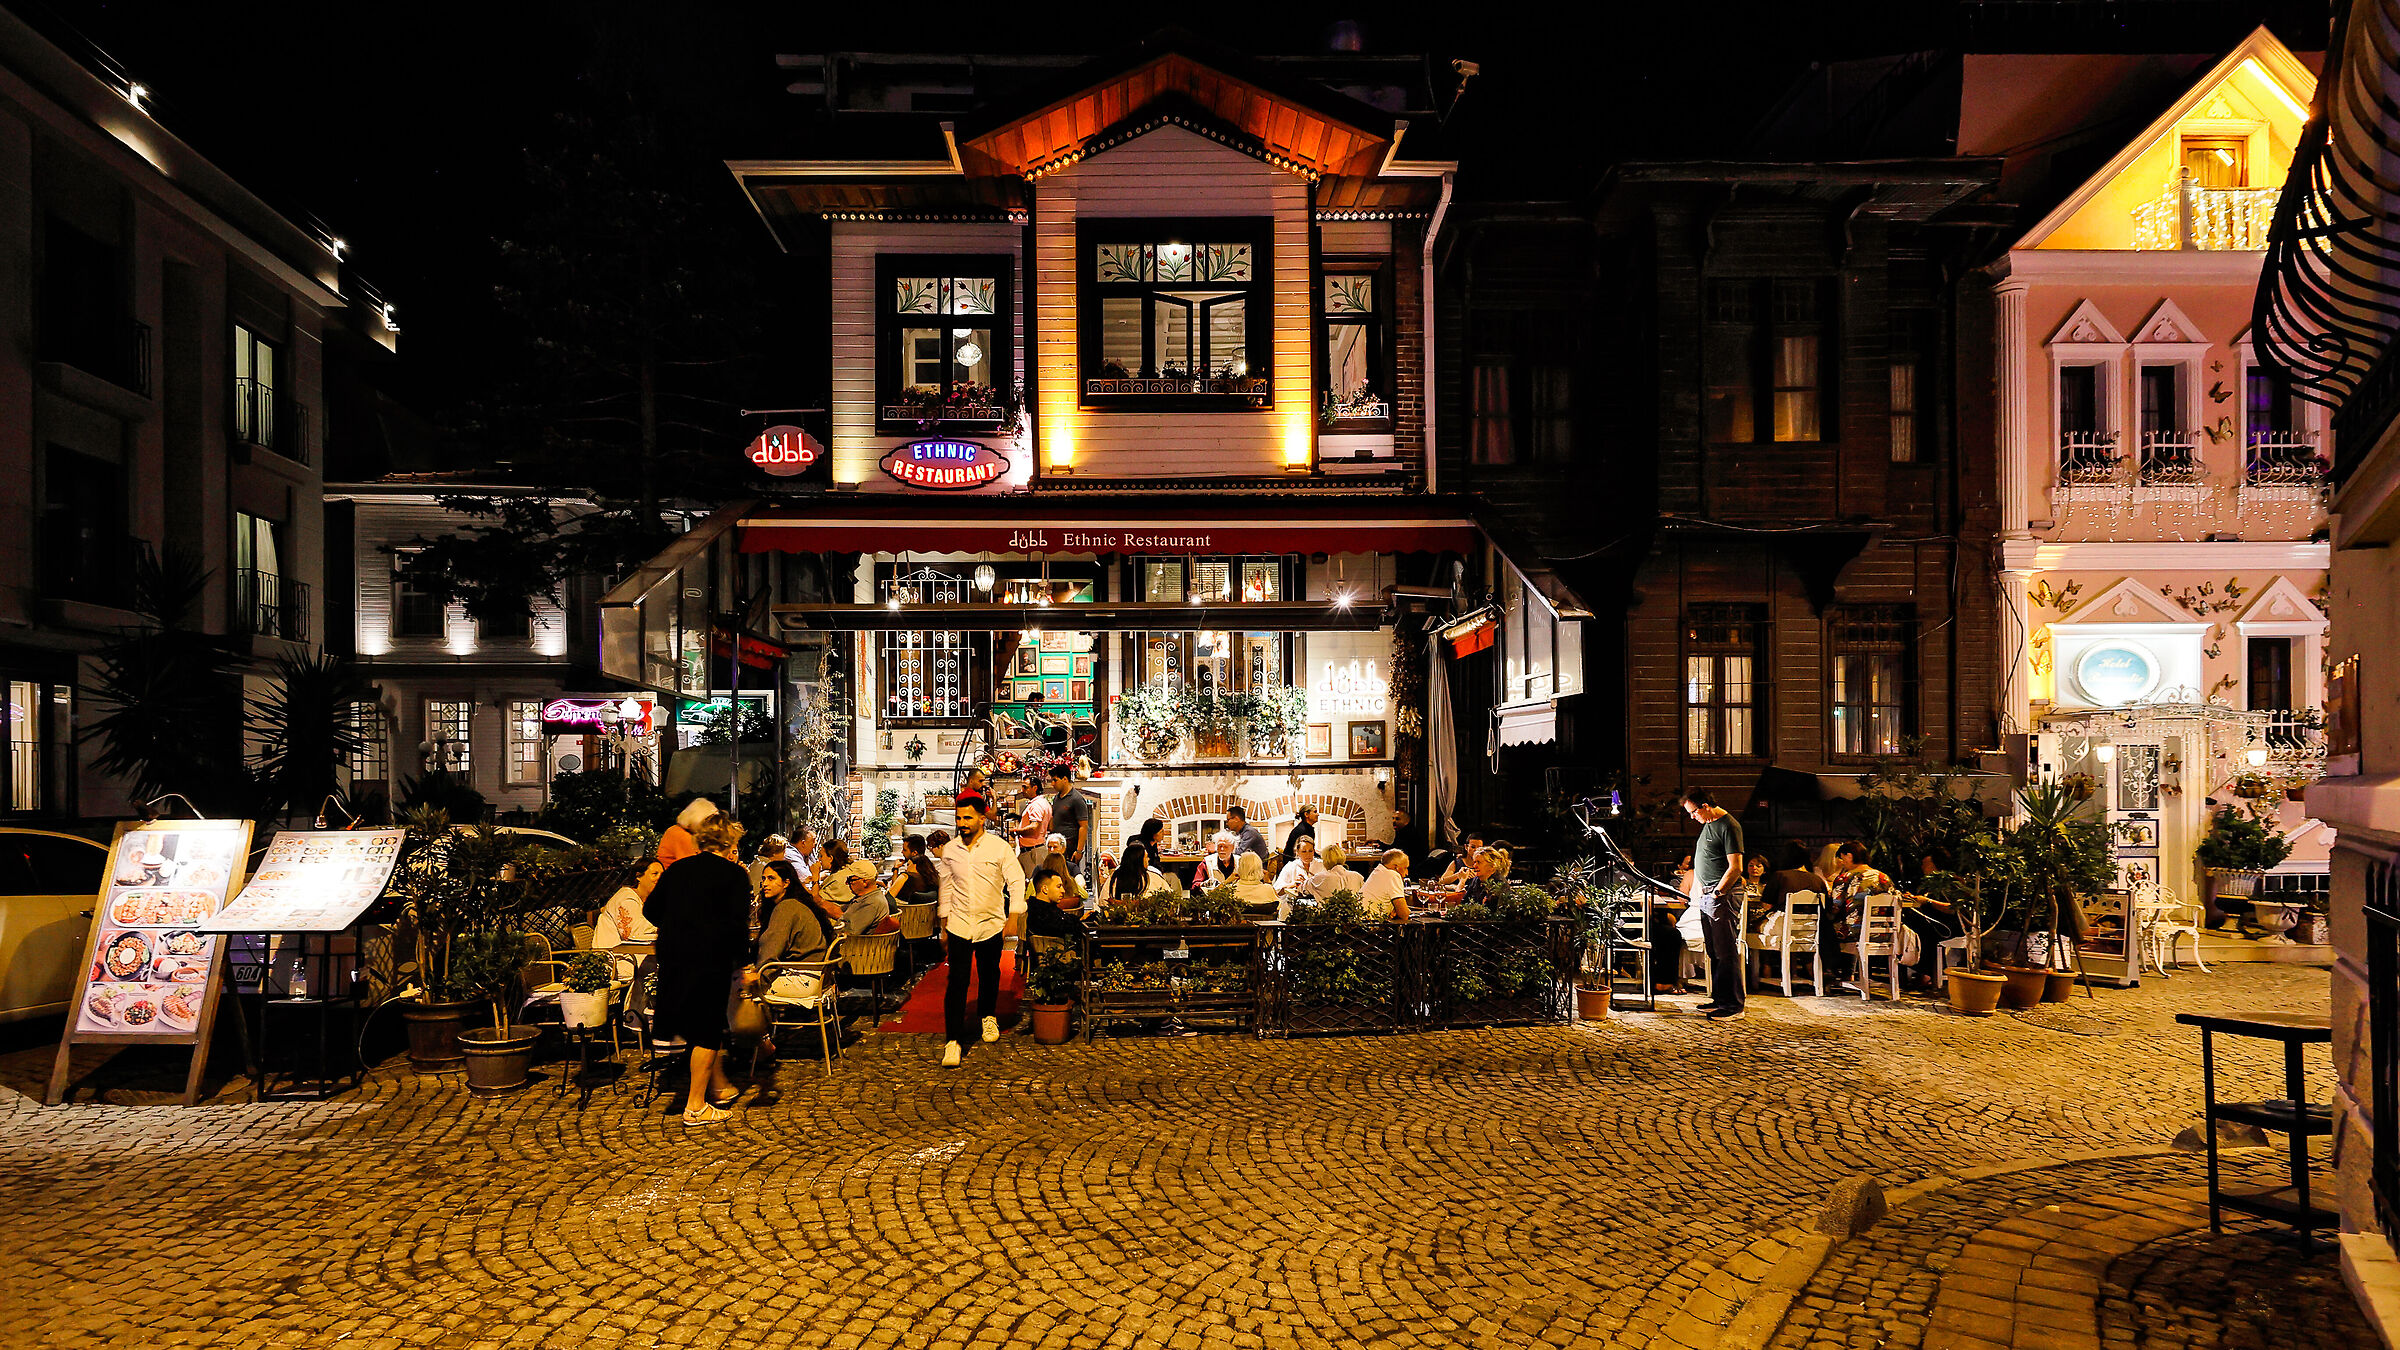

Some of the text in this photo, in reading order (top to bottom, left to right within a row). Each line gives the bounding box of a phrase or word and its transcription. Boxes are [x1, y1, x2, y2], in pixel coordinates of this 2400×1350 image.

[913, 443, 976, 462] ETHNIC
[892, 459, 996, 484] RESTAURANT
[1063, 533, 1117, 547] Ethnic
[1124, 533, 1211, 547] Restaurant
[1320, 698, 1384, 711] ETHNIC
